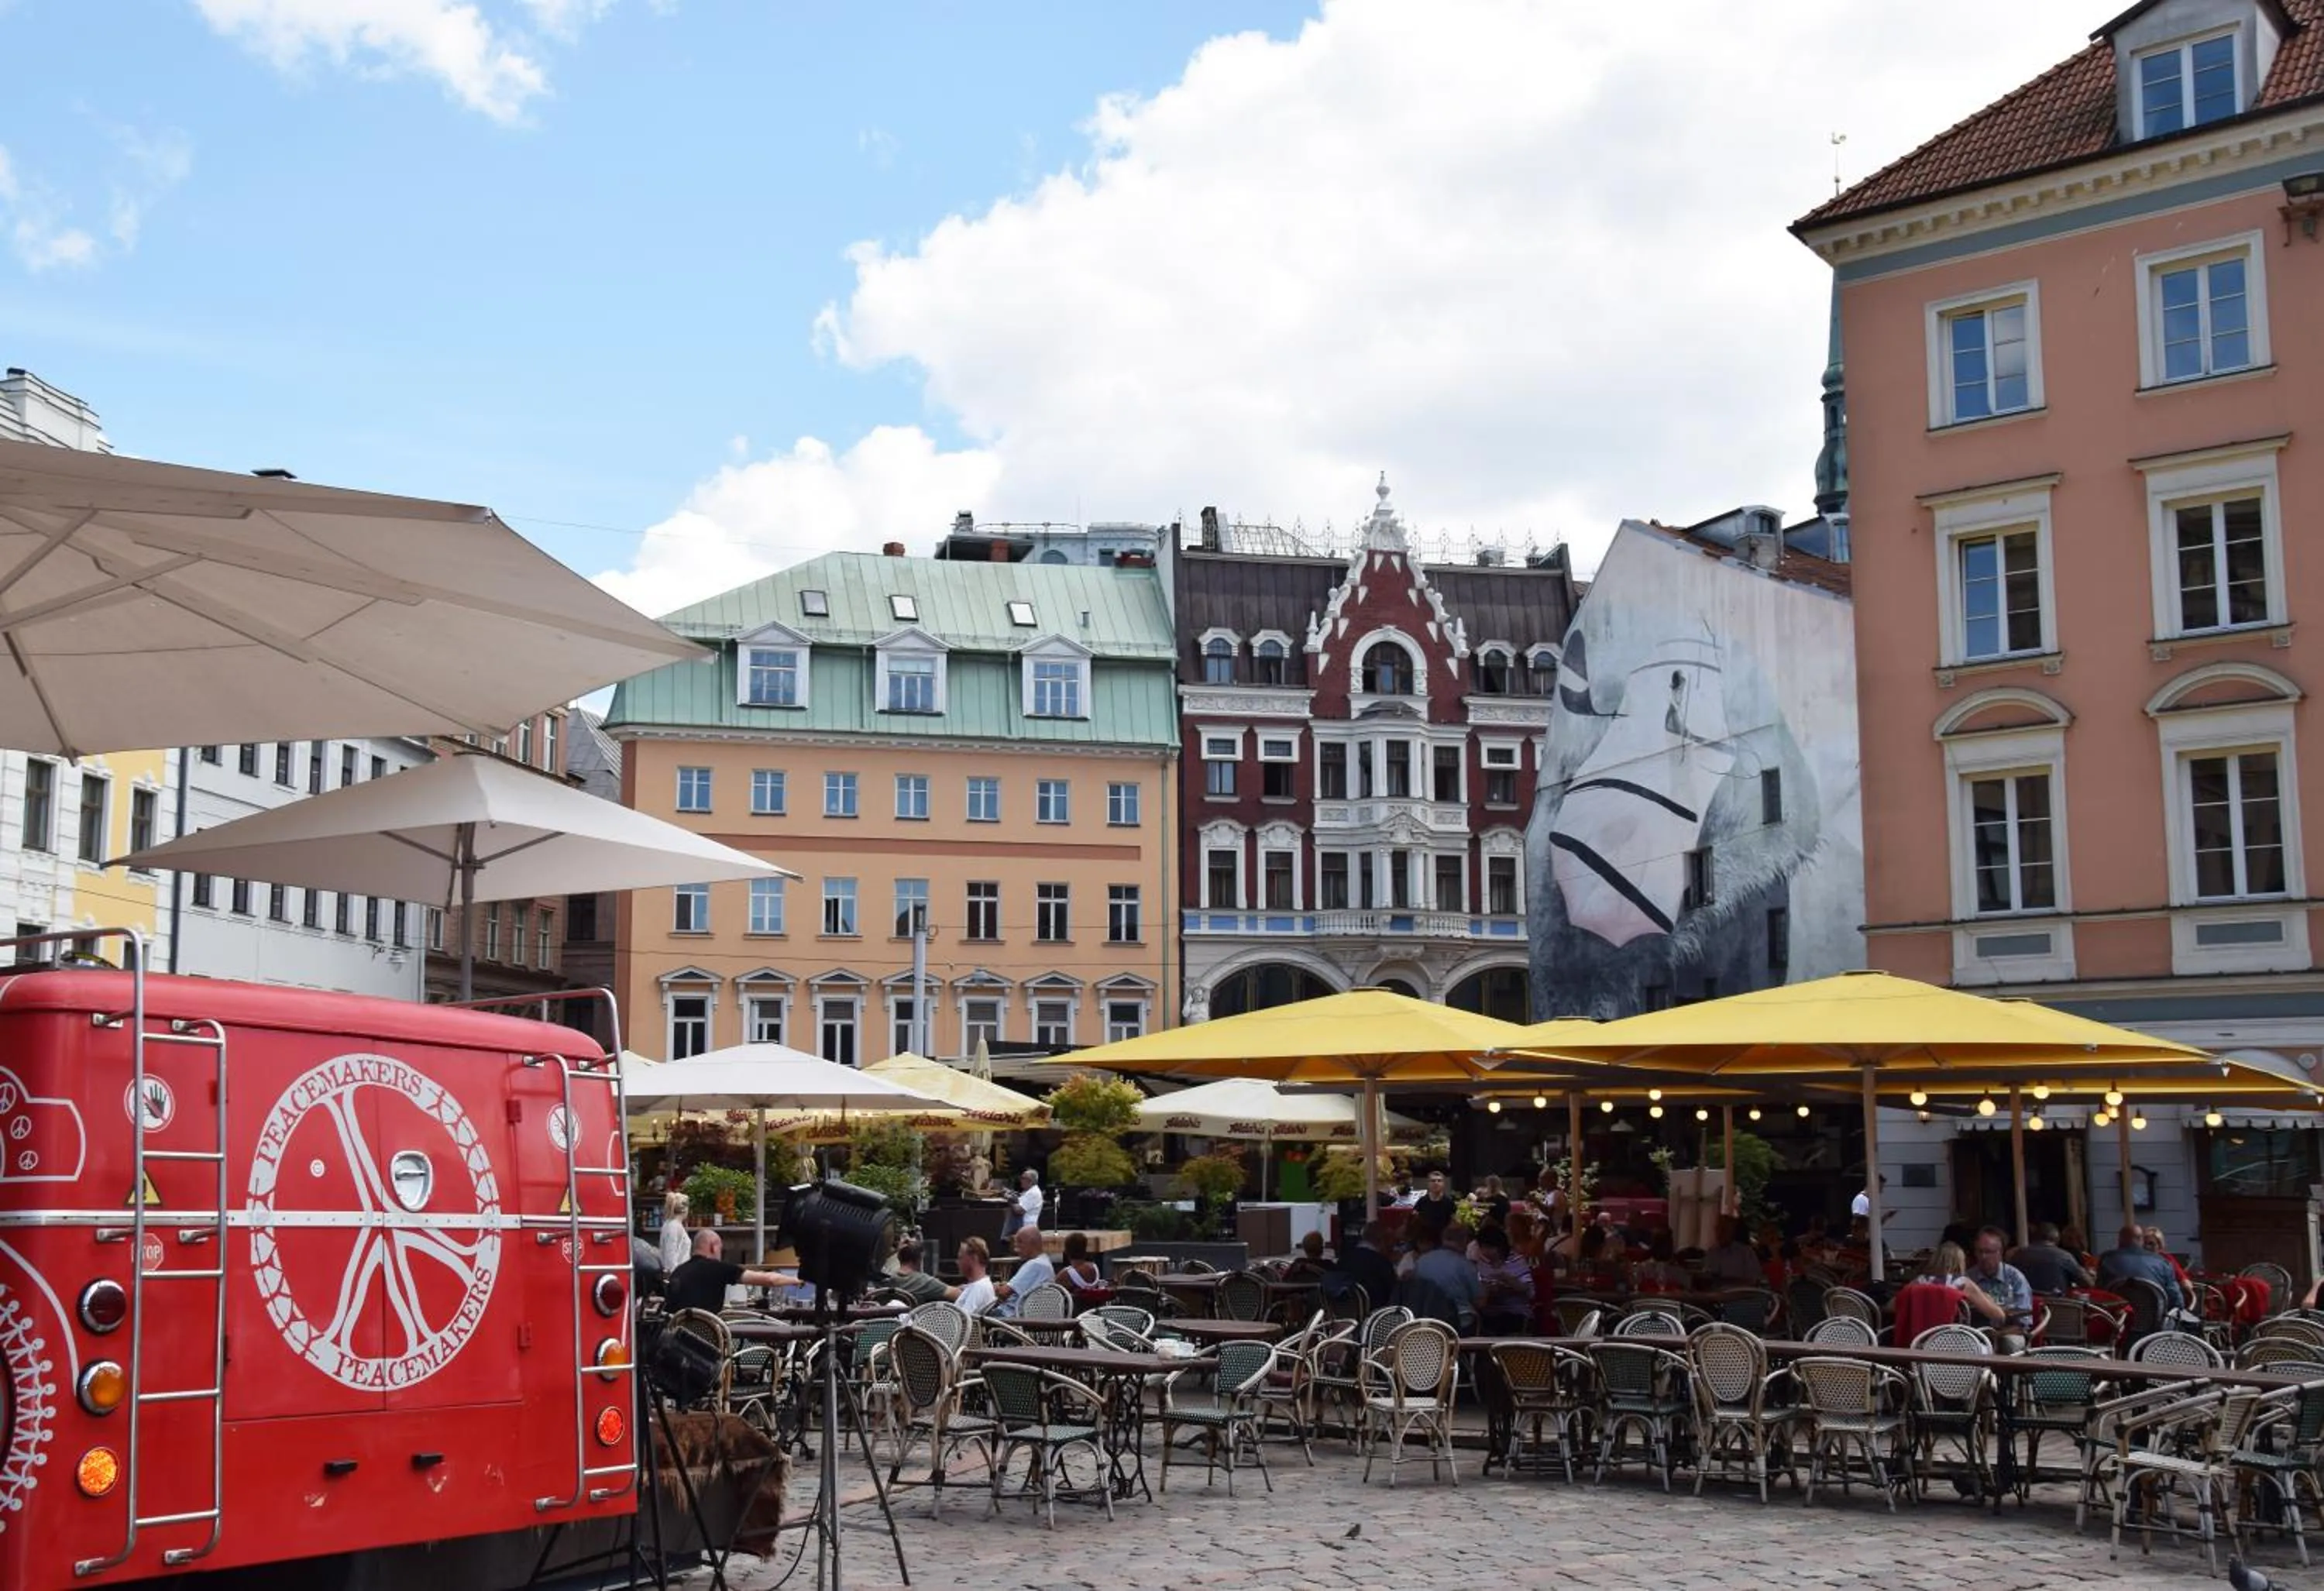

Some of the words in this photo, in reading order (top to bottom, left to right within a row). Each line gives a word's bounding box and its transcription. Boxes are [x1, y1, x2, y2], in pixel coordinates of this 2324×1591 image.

[256, 1059, 422, 1167] PEACEMAKERS
[140, 1245, 161, 1259] TOP
[333, 1266, 492, 1387] PEACEMAKERS
